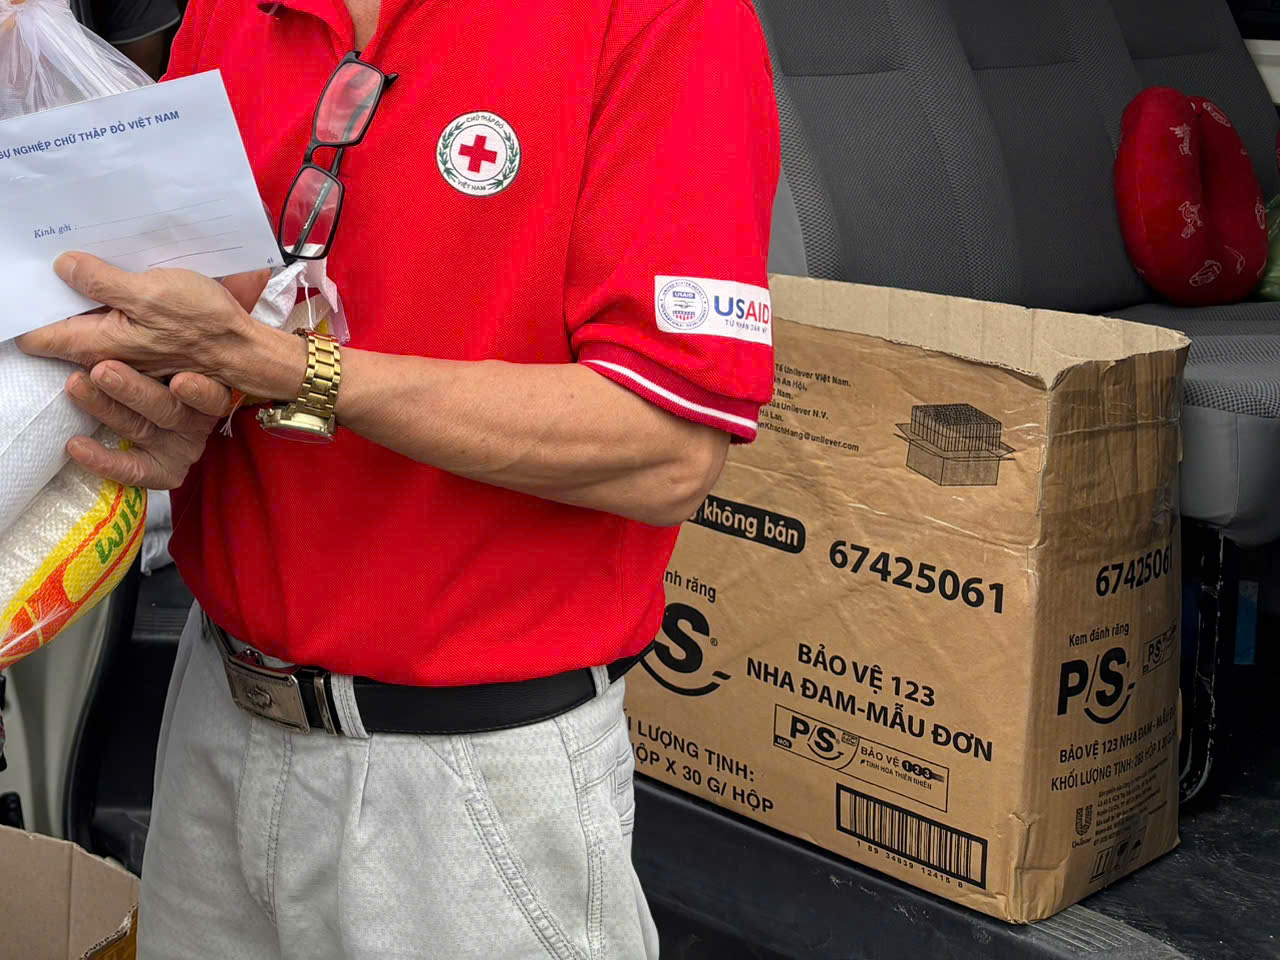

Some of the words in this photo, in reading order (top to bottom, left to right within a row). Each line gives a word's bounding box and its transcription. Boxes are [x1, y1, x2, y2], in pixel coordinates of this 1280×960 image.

[13, 141, 52, 157] NGHIỆP
[54, 134, 77, 148] CHỮ
[78, 127, 107, 141] THẬP
[110, 121, 126, 134] ĐỎ
[127, 116, 153, 130] VIỆT
[155, 111, 180, 124] NAM
[34, 226, 56, 239] Kính
[714, 295, 769, 324] USAID
[784, 366, 813, 379] Unilever
[815, 372, 830, 383] Việt
[781, 402, 811, 416] Unilever
[703, 498, 758, 538] không
[764, 515, 799, 546] bán
[829, 540, 1004, 614] 67425061
[1096, 543, 1173, 596] 67425061
[686, 577, 717, 604] răng
[1069, 632, 1087, 647] Kem
[1089, 626, 1110, 642] đánh
[1111, 623, 1130, 637] răng
[798, 643, 847, 677] BẢO
[852, 661, 883, 695] VỆ
[891, 676, 935, 707] 123
[747, 657, 795, 693] NHA
[931, 723, 993, 762] ĐƠN
[638, 720, 699, 760] LƯỢNG
[704, 749, 754, 782] TỊNH:
[861, 746, 883, 761] BẢO
[886, 755, 900, 768] VỆ
[1060, 744, 1083, 763] BẢO
[1085, 740, 1099, 760] VỆ
[1102, 738, 1118, 755] 123
[665, 757, 677, 775] X
[683, 766, 701, 785] 30
[707, 777, 727, 796] G/
[733, 786, 774, 813] HỘP
[1051, 768, 1078, 792] KHỐI
[1080, 764, 1111, 786] LƯỢNG
